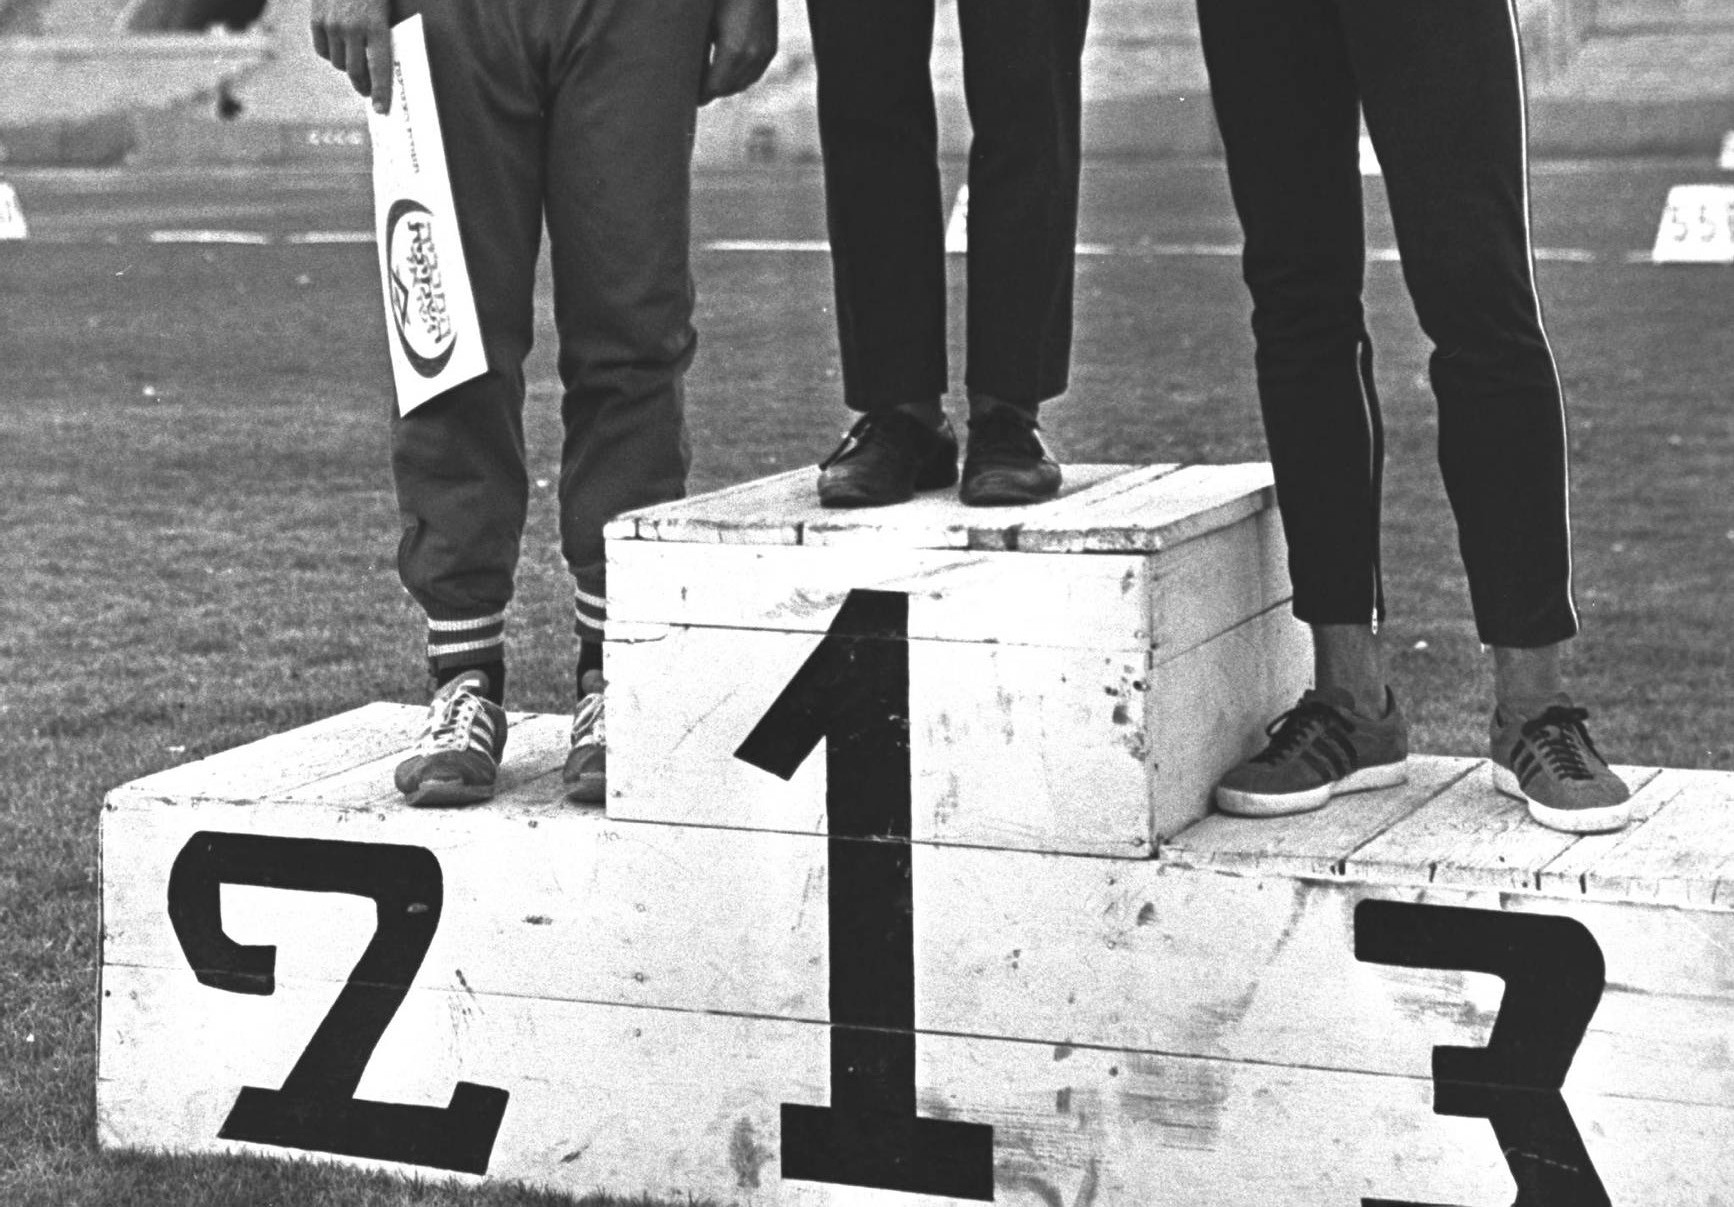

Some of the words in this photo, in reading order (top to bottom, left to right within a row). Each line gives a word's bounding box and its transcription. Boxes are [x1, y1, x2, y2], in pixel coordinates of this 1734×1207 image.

[168, 829, 509, 1176] 2
[733, 590, 995, 1201] 1
[1354, 898, 1607, 1207] 3
